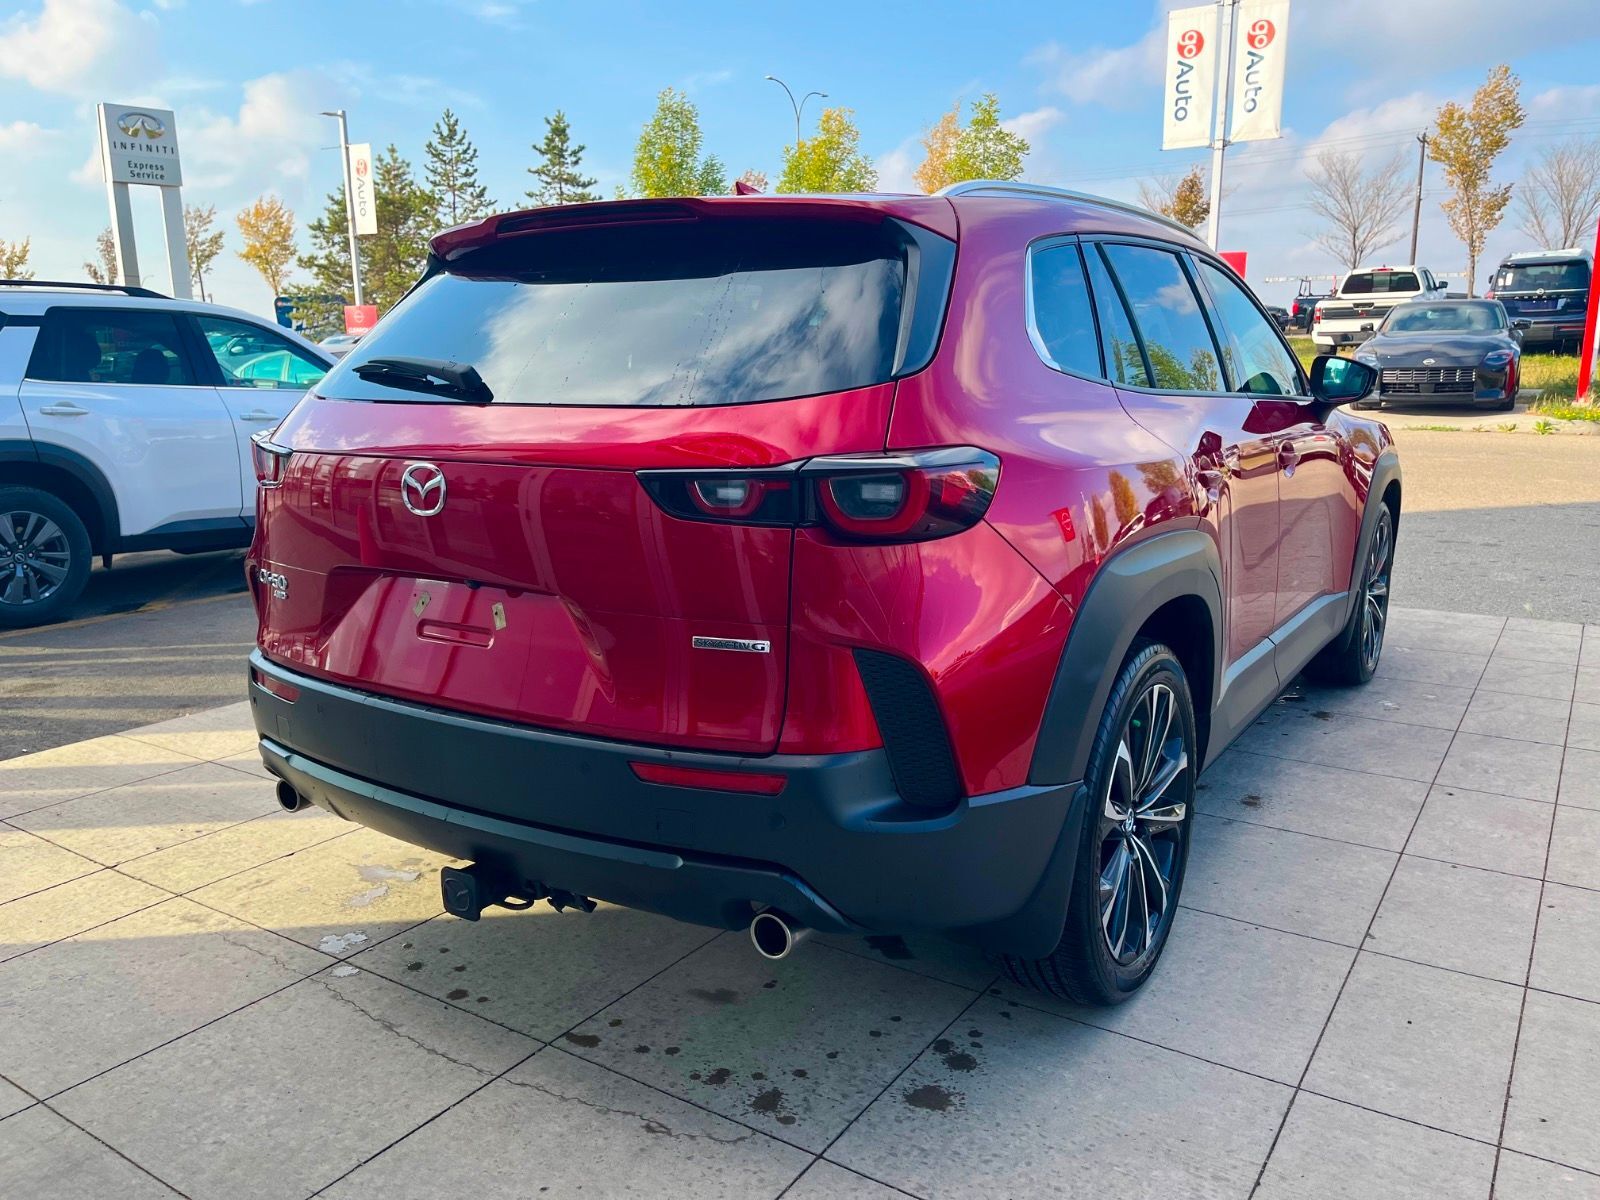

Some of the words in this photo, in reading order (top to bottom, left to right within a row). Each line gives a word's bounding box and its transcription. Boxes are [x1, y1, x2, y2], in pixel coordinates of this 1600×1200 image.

[1174, 61, 1194, 122] Auto
[1244, 51, 1264, 113] Auto
[113, 141, 175, 155] INFINITI
[127, 160, 165, 171] Express
[129, 169, 166, 180] Service
[356, 177, 367, 217] Auto
